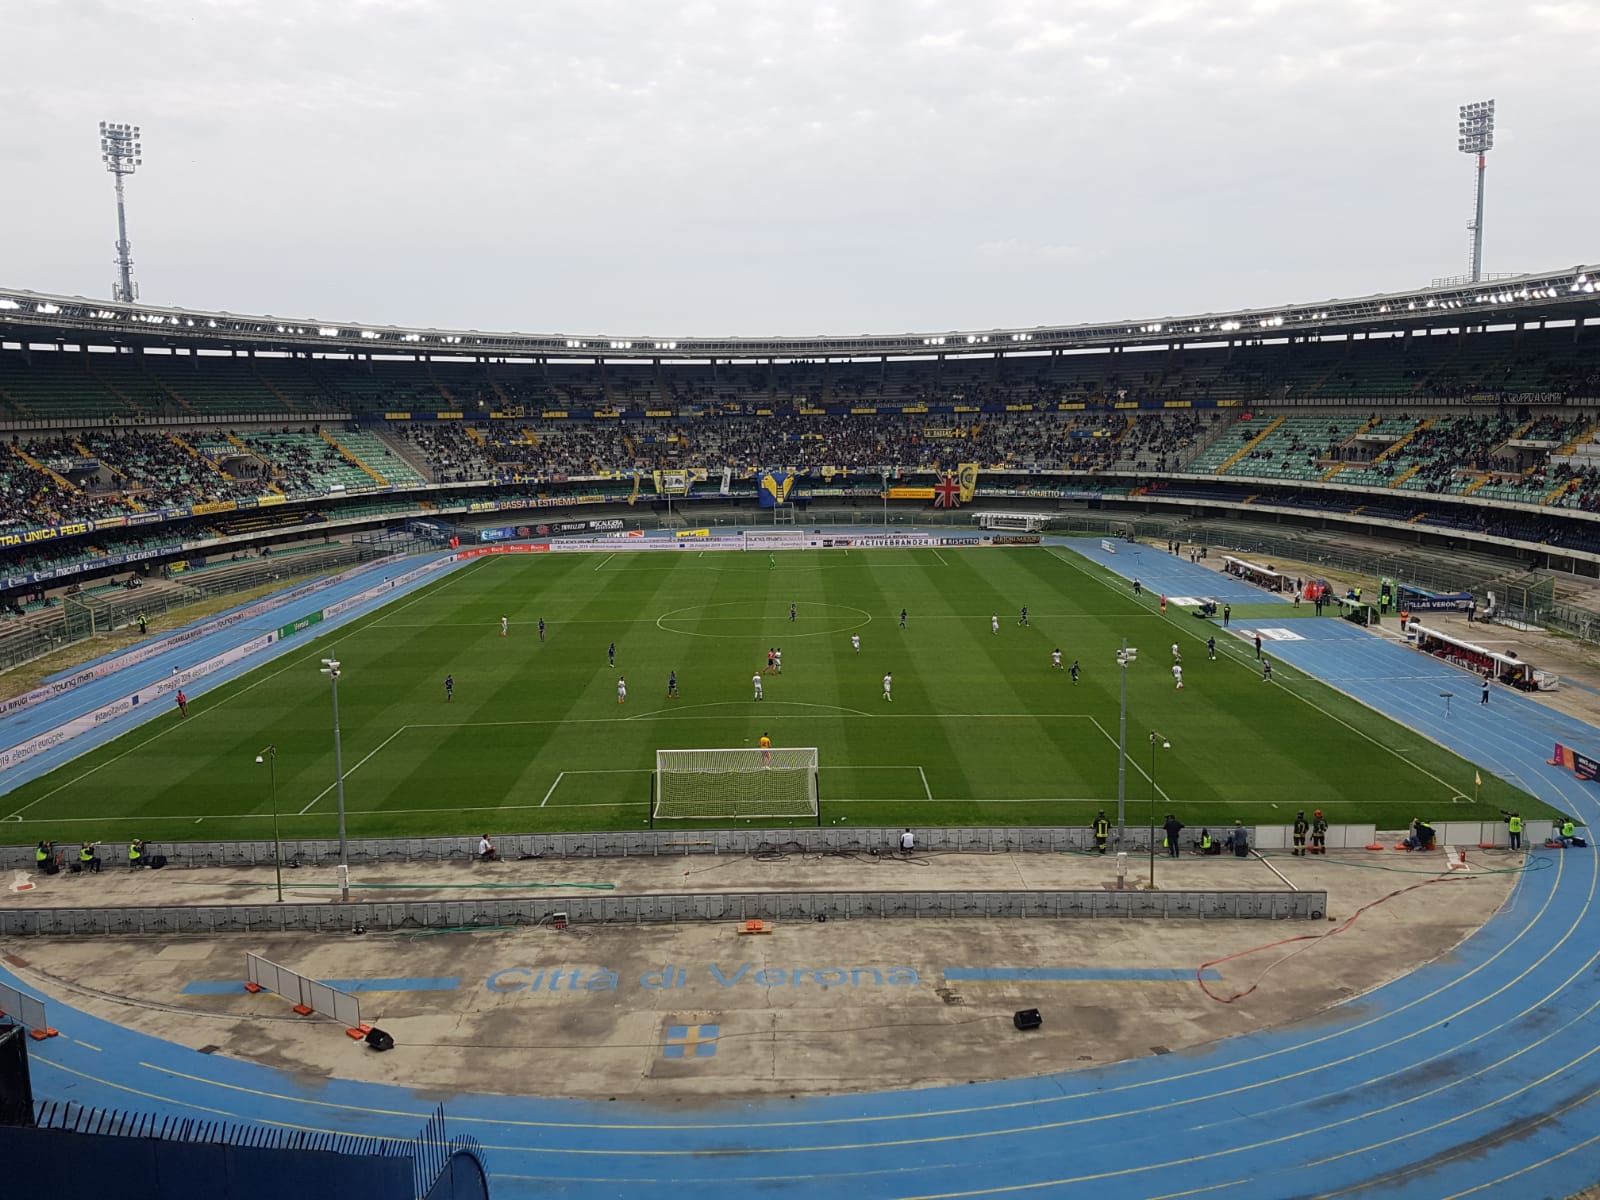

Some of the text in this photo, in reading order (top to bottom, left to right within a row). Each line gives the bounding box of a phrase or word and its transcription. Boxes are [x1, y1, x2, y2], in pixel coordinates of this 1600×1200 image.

[500, 500, 527, 510] BASSA
[538, 497, 577, 507] ESTREMA
[24, 528, 57, 542] UNICA
[60, 523, 87, 536] FEDE
[56, 564, 81, 577] macron
[52, 671, 94, 694] Young man
[36, 731, 65, 749] europee
[486, 963, 919, 993] Città di Verona
